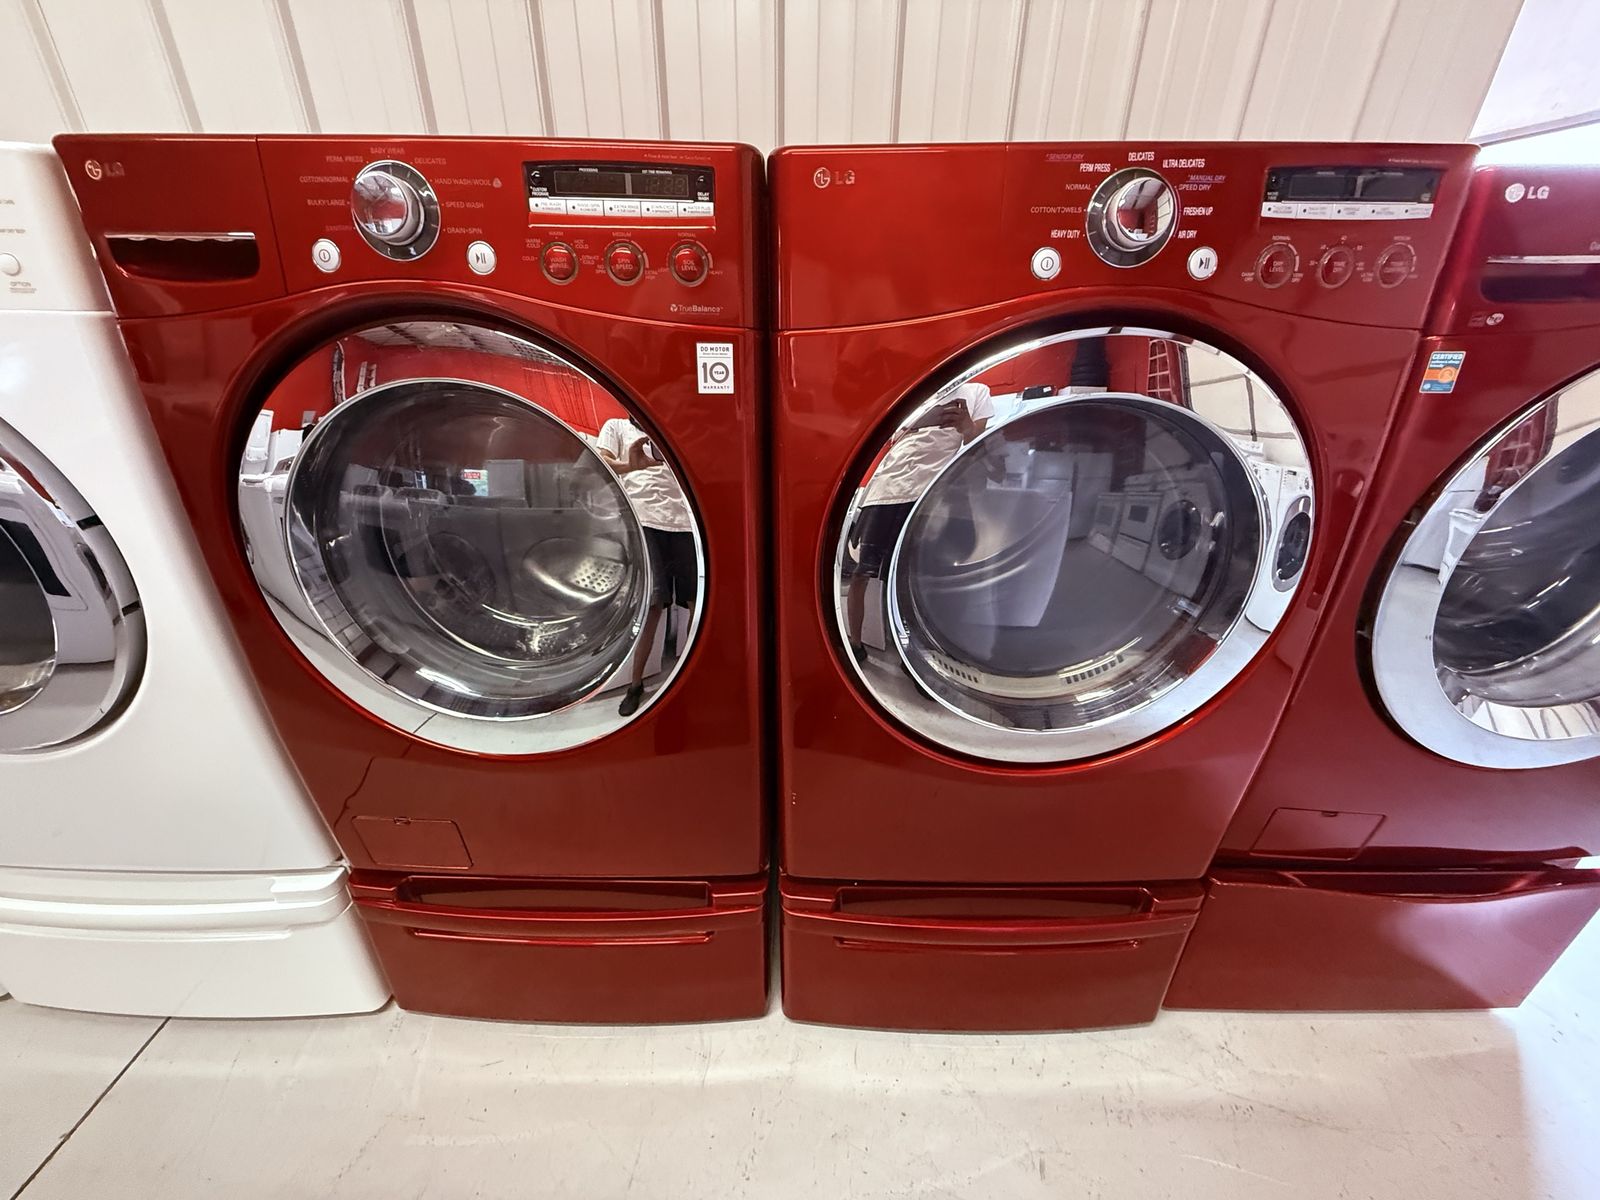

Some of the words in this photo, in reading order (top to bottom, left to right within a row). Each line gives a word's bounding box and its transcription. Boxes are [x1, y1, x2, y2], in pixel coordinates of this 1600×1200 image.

[414, 157, 447, 165] DELICATES
[1128, 151, 1155, 162] DELICATES
[1162, 159, 1178, 168] ULTRA
[1178, 158, 1206, 168] DELICATES
[1080, 163, 1094, 173] PERM
[1094, 163, 1111, 173] PRESS
[299, 175, 350, 183] COTTON/NORMAL
[1065, 183, 1092, 191] NORMAL
[1178, 183, 1198, 191] SPEED
[1198, 183, 1212, 191] DRY
[1030, 206, 1082, 214] COTTON/TOWELS
[1183, 206, 1205, 216] FRESHEN
[1205, 206, 1214, 216] UP
[1050, 229, 1067, 239] HEAVY
[1067, 229, 1081, 239] DUTY
[1177, 230, 1187, 239] AIR
[1186, 230, 1198, 239] DRY
[678, 304, 721, 313] TrueBalance
[702, 361, 730, 384] 10
